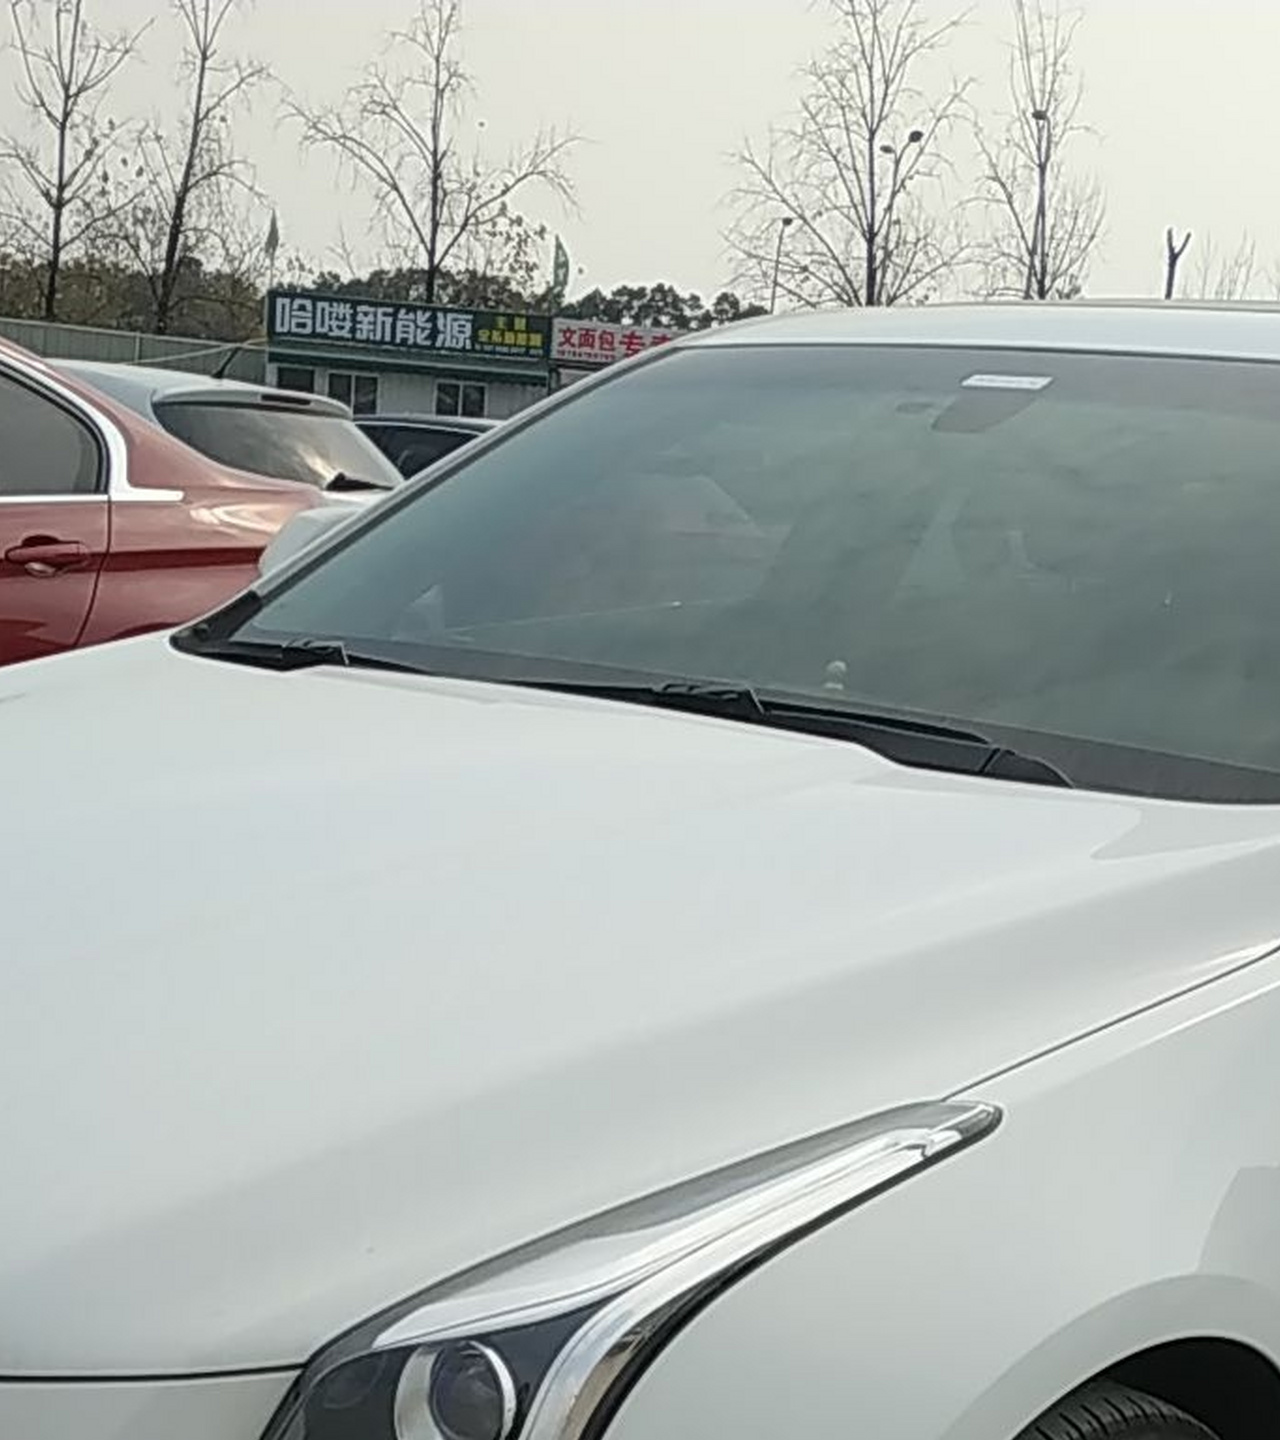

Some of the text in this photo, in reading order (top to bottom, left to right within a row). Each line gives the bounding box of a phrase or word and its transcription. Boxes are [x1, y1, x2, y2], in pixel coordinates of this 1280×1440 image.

[275, 297, 474, 350] 哈喽新能源
